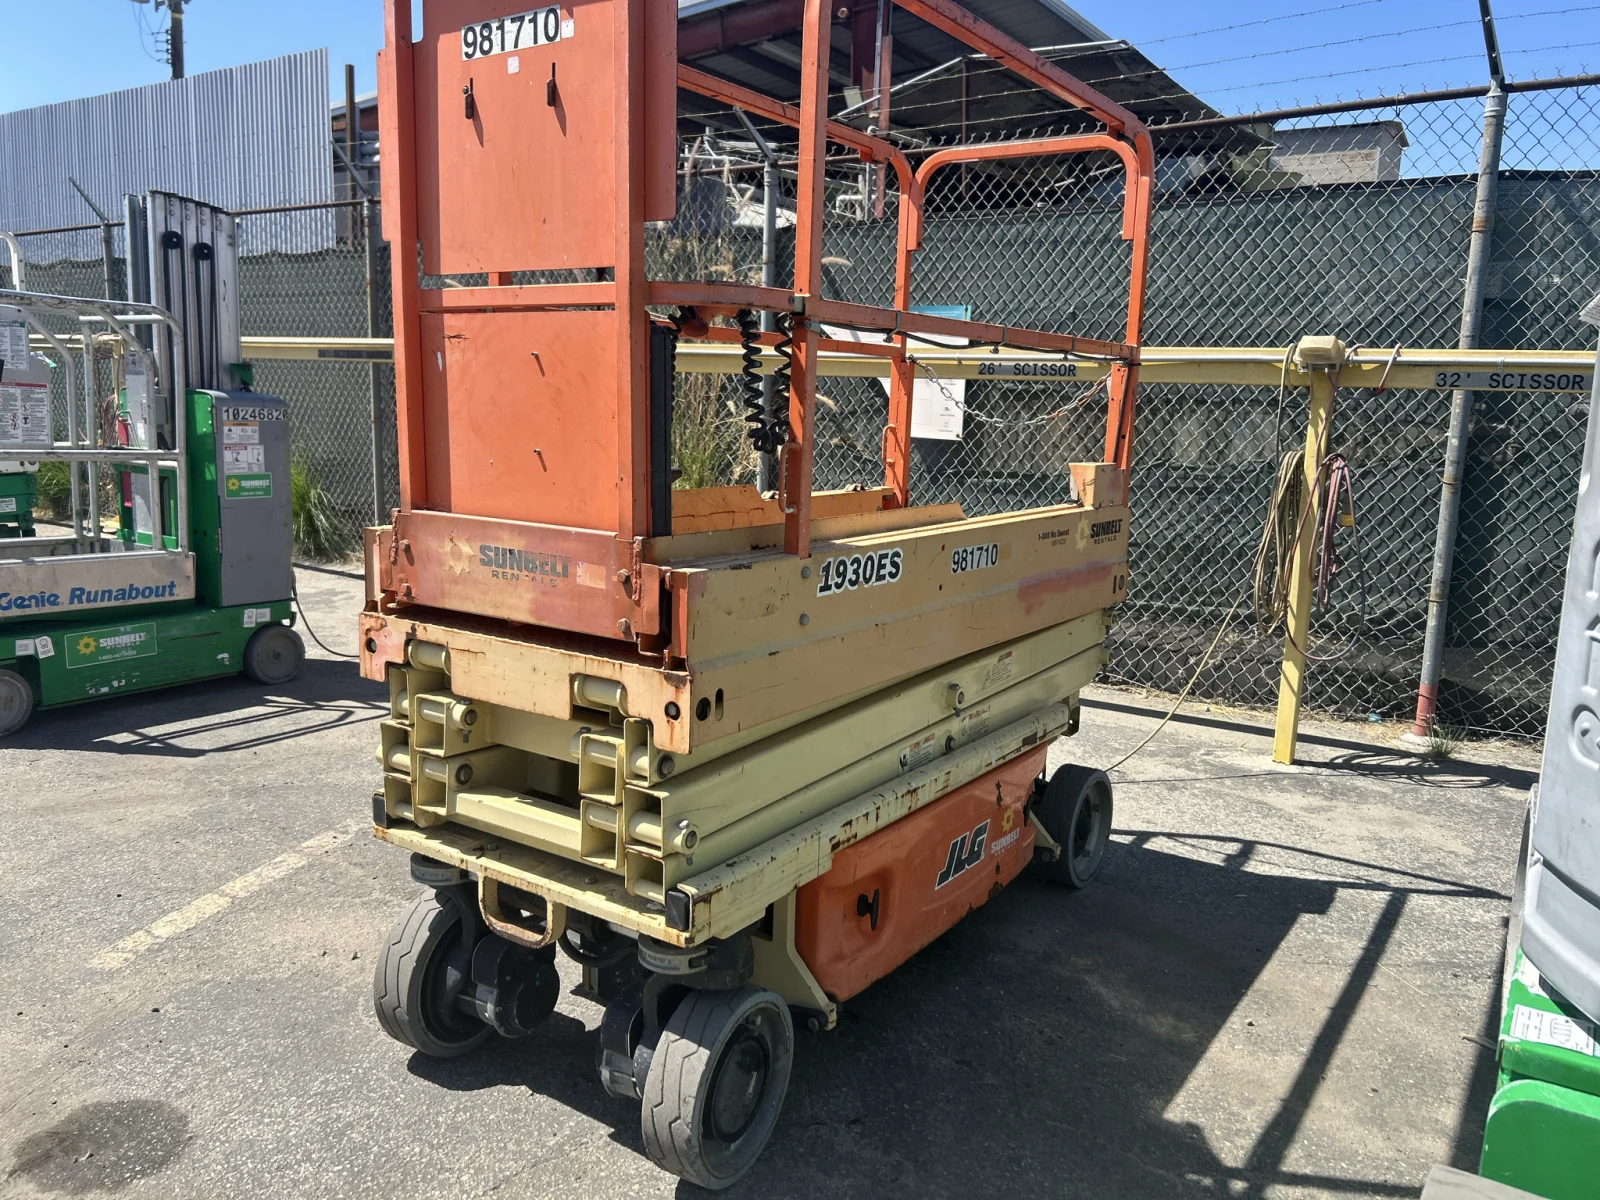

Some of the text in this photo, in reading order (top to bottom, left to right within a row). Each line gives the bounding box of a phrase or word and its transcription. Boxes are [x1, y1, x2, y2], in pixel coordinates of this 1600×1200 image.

[463, 7, 560, 59] 981710
[978, 362, 1077, 377] 26' SCISSOR
[1436, 372, 1586, 391] 32' SCISSOR
[224, 408, 288, 420] 10246820
[241, 479, 270, 487] SUNBELT
[1057, 528, 1070, 538] Sweat
[1090, 518, 1123, 539] SUNBELT
[1093, 535, 1117, 545] RENTALS
[479, 544, 573, 579] SUNBELT
[952, 543, 998, 574] 981710
[818, 549, 903, 594] 1930ES
[0, 581, 176, 611] Genie Runabout
[99, 632, 146, 647] SUNBELT
[990, 827, 1020, 854] SUNBELT
[934, 818, 990, 891] JLG
